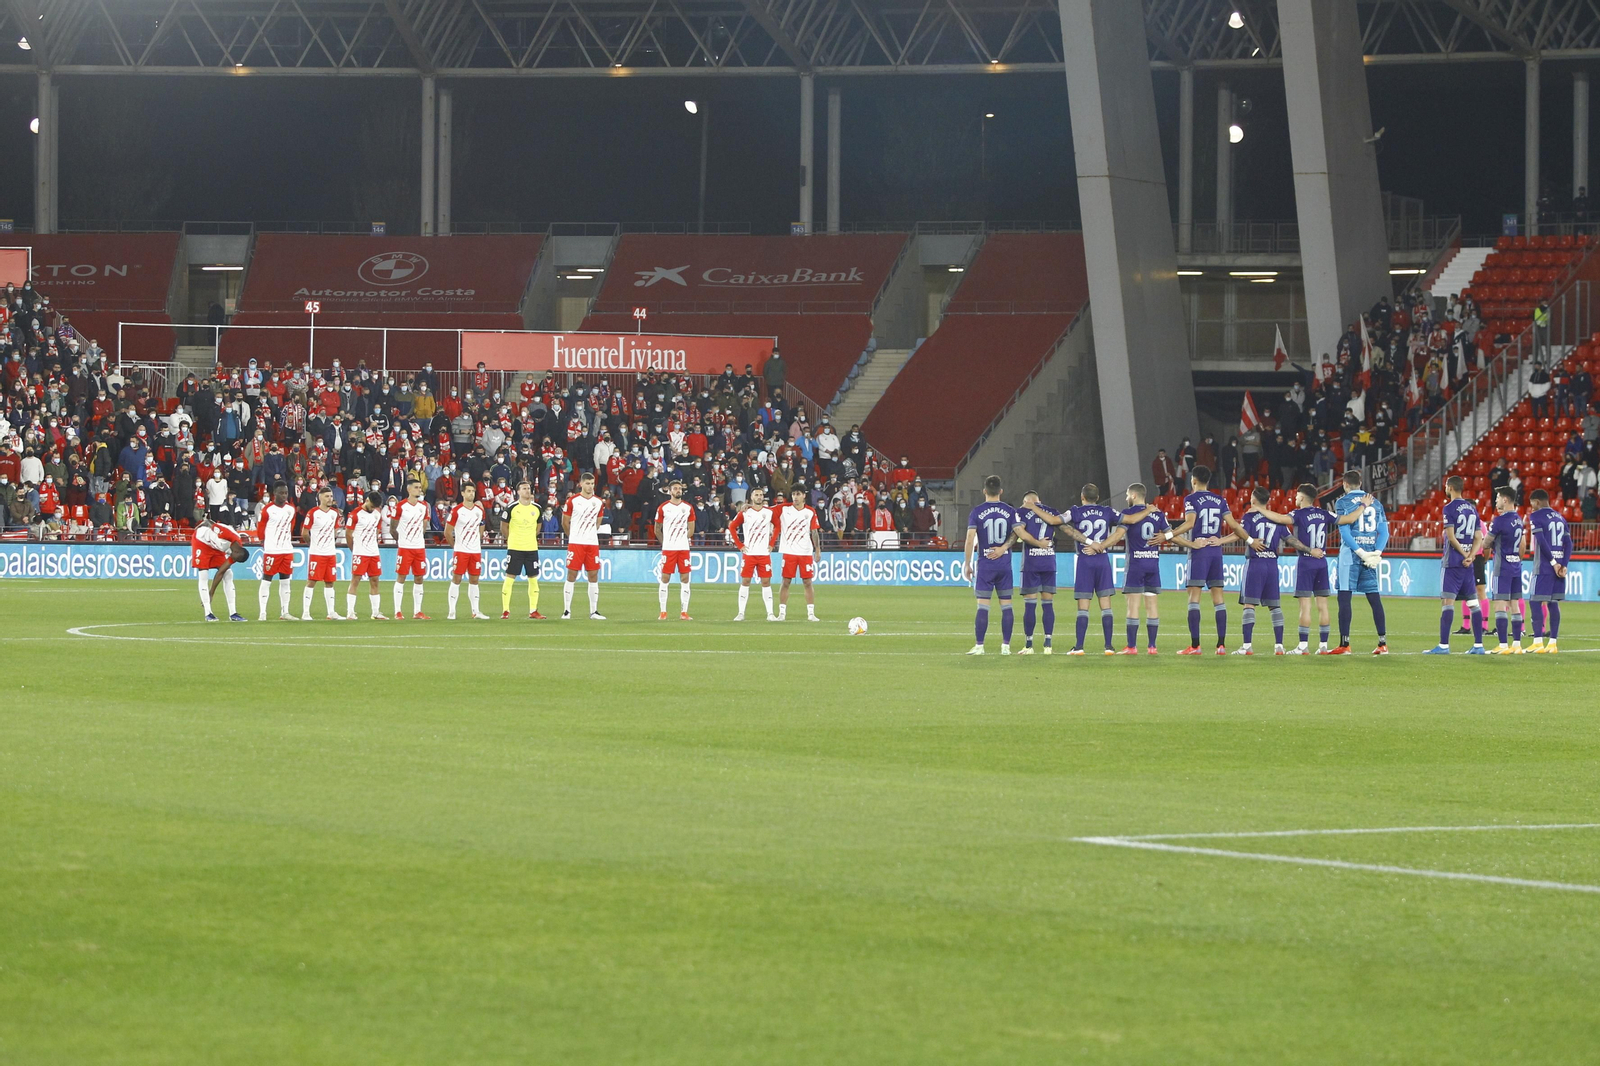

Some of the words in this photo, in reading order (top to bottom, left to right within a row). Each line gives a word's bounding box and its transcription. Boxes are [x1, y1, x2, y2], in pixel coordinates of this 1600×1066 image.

[371, 254, 421, 263] BMW
[702, 267, 864, 284] CaixaBank
[294, 287, 411, 297] Automotor
[417, 287, 476, 296] Costa
[305, 301, 320, 313] 45
[633, 308, 647, 319] 44
[552, 335, 688, 371] FuenteLiviana
[1372, 463, 1388, 479] APC
[1082, 509, 1104, 518] NACHO
[1198, 508, 1221, 534] 15
[1358, 507, 1377, 532] 13
[983, 518, 1008, 545] 10
[1078, 518, 1107, 544] 22
[1255, 522, 1277, 548] 17
[1307, 523, 1327, 550] 16
[1455, 514, 1477, 540] 24
[1548, 521, 1565, 547] 12
[195, 549, 202, 557] 9
[1513, 528, 1522, 553] 2
[265, 556, 275, 565] 31
[310, 561, 318, 570] 17
[352, 555, 361, 565] 26
[690, 552, 740, 584] PDR
[811, 553, 974, 582] palaisdesroses.co
